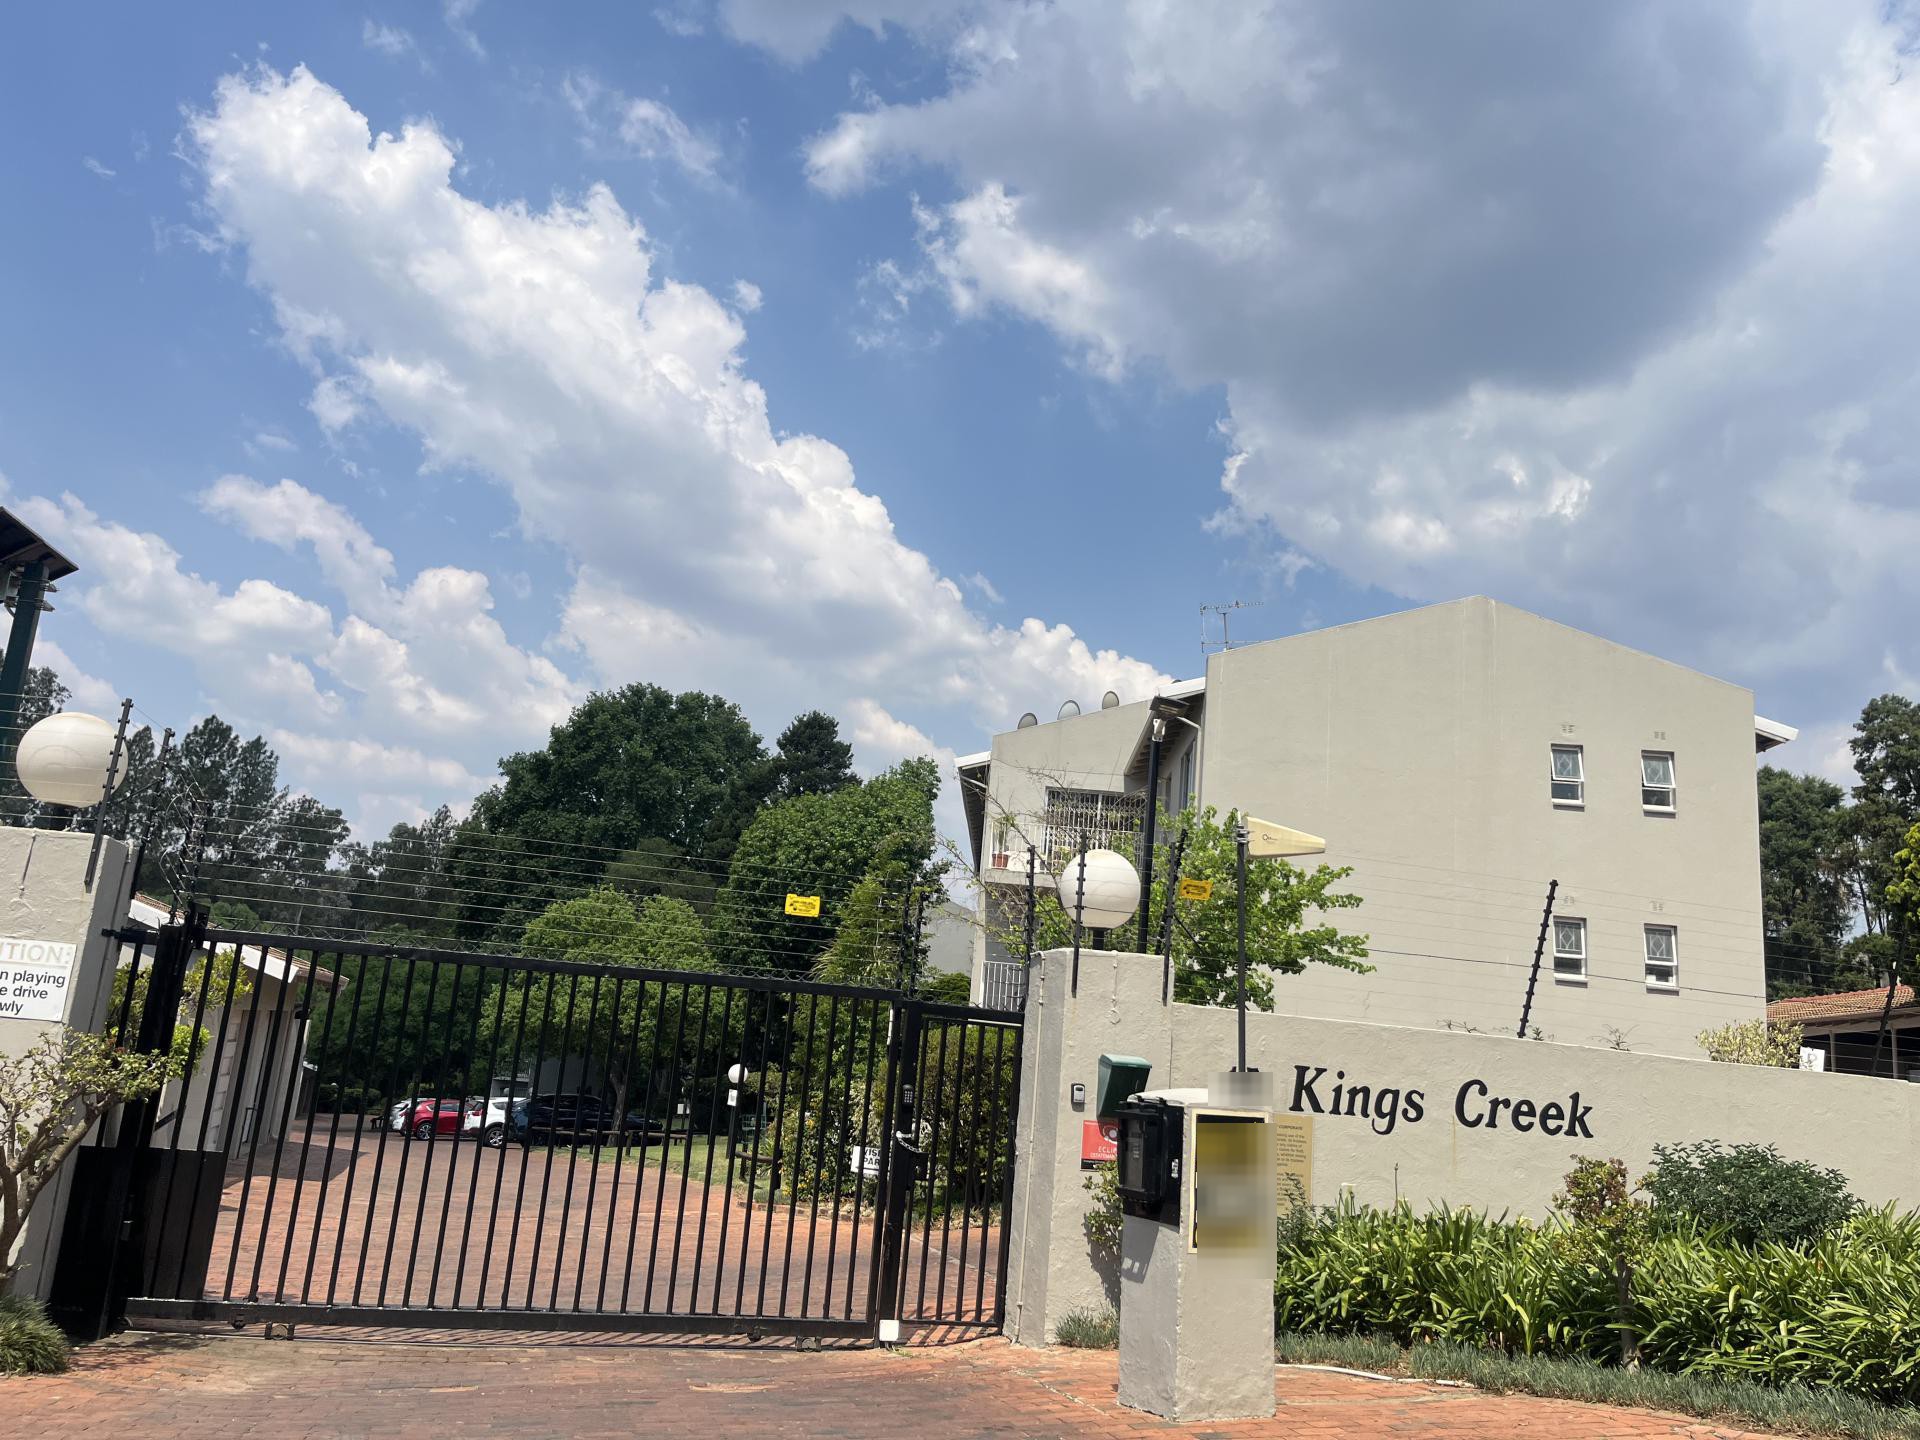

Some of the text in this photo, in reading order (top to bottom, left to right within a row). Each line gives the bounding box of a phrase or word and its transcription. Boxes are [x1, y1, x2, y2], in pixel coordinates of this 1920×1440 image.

[0, 942, 70, 964] TION:
[12, 970, 66, 988] playing
[13, 985, 48, 999] drive
[1288, 1065, 1594, 1139] Kings Creek
